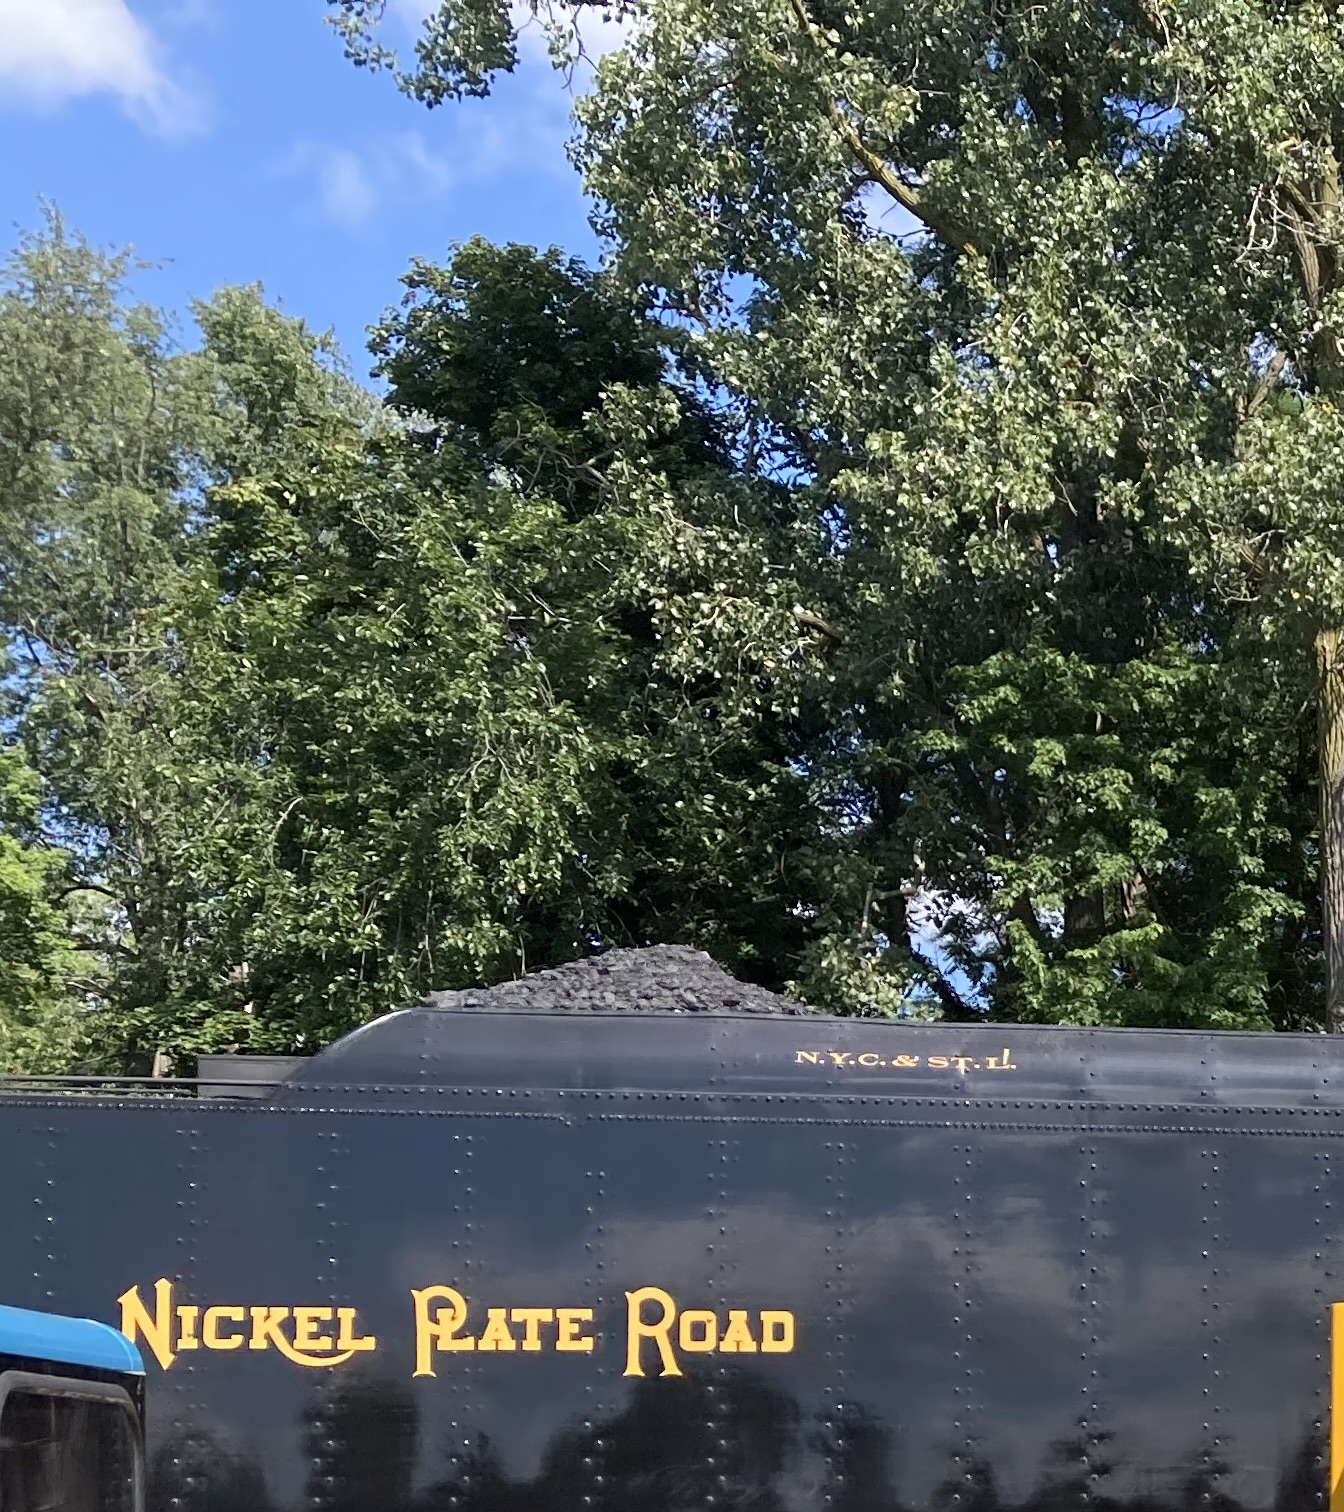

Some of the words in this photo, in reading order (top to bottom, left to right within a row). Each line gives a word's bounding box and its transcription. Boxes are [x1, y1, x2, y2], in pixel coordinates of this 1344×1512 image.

[892, 1055, 919, 1067] &
[117, 1277, 377, 1370] NICKEL
[411, 1284, 594, 1377] PLATE
[624, 1286, 796, 1377] ROAD
